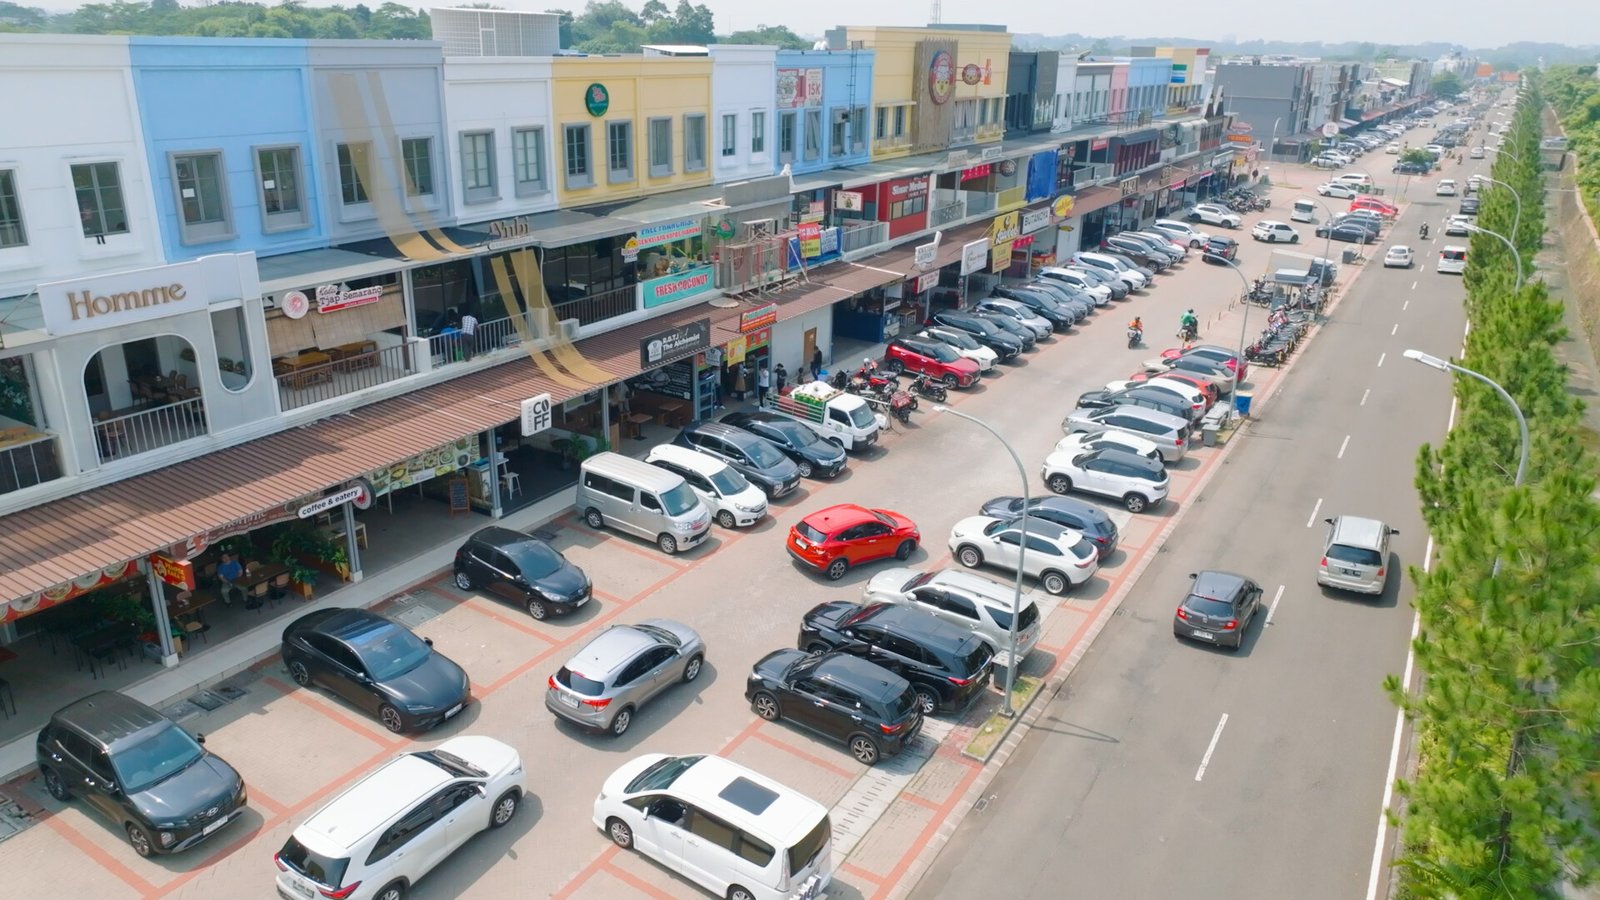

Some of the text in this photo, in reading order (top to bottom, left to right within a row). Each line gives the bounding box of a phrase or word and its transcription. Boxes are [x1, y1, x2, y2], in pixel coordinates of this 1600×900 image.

[808, 83, 821, 95] 15K
[320, 294, 341, 306] Tjap
[343, 286, 382, 300] Semarang
[655, 274, 708, 297] FRESH COCONUT
[66, 283, 187, 321] Homme
[663, 343, 673, 351] The
[302, 502, 327, 515] coffee
[335, 489, 359, 502] eatery
